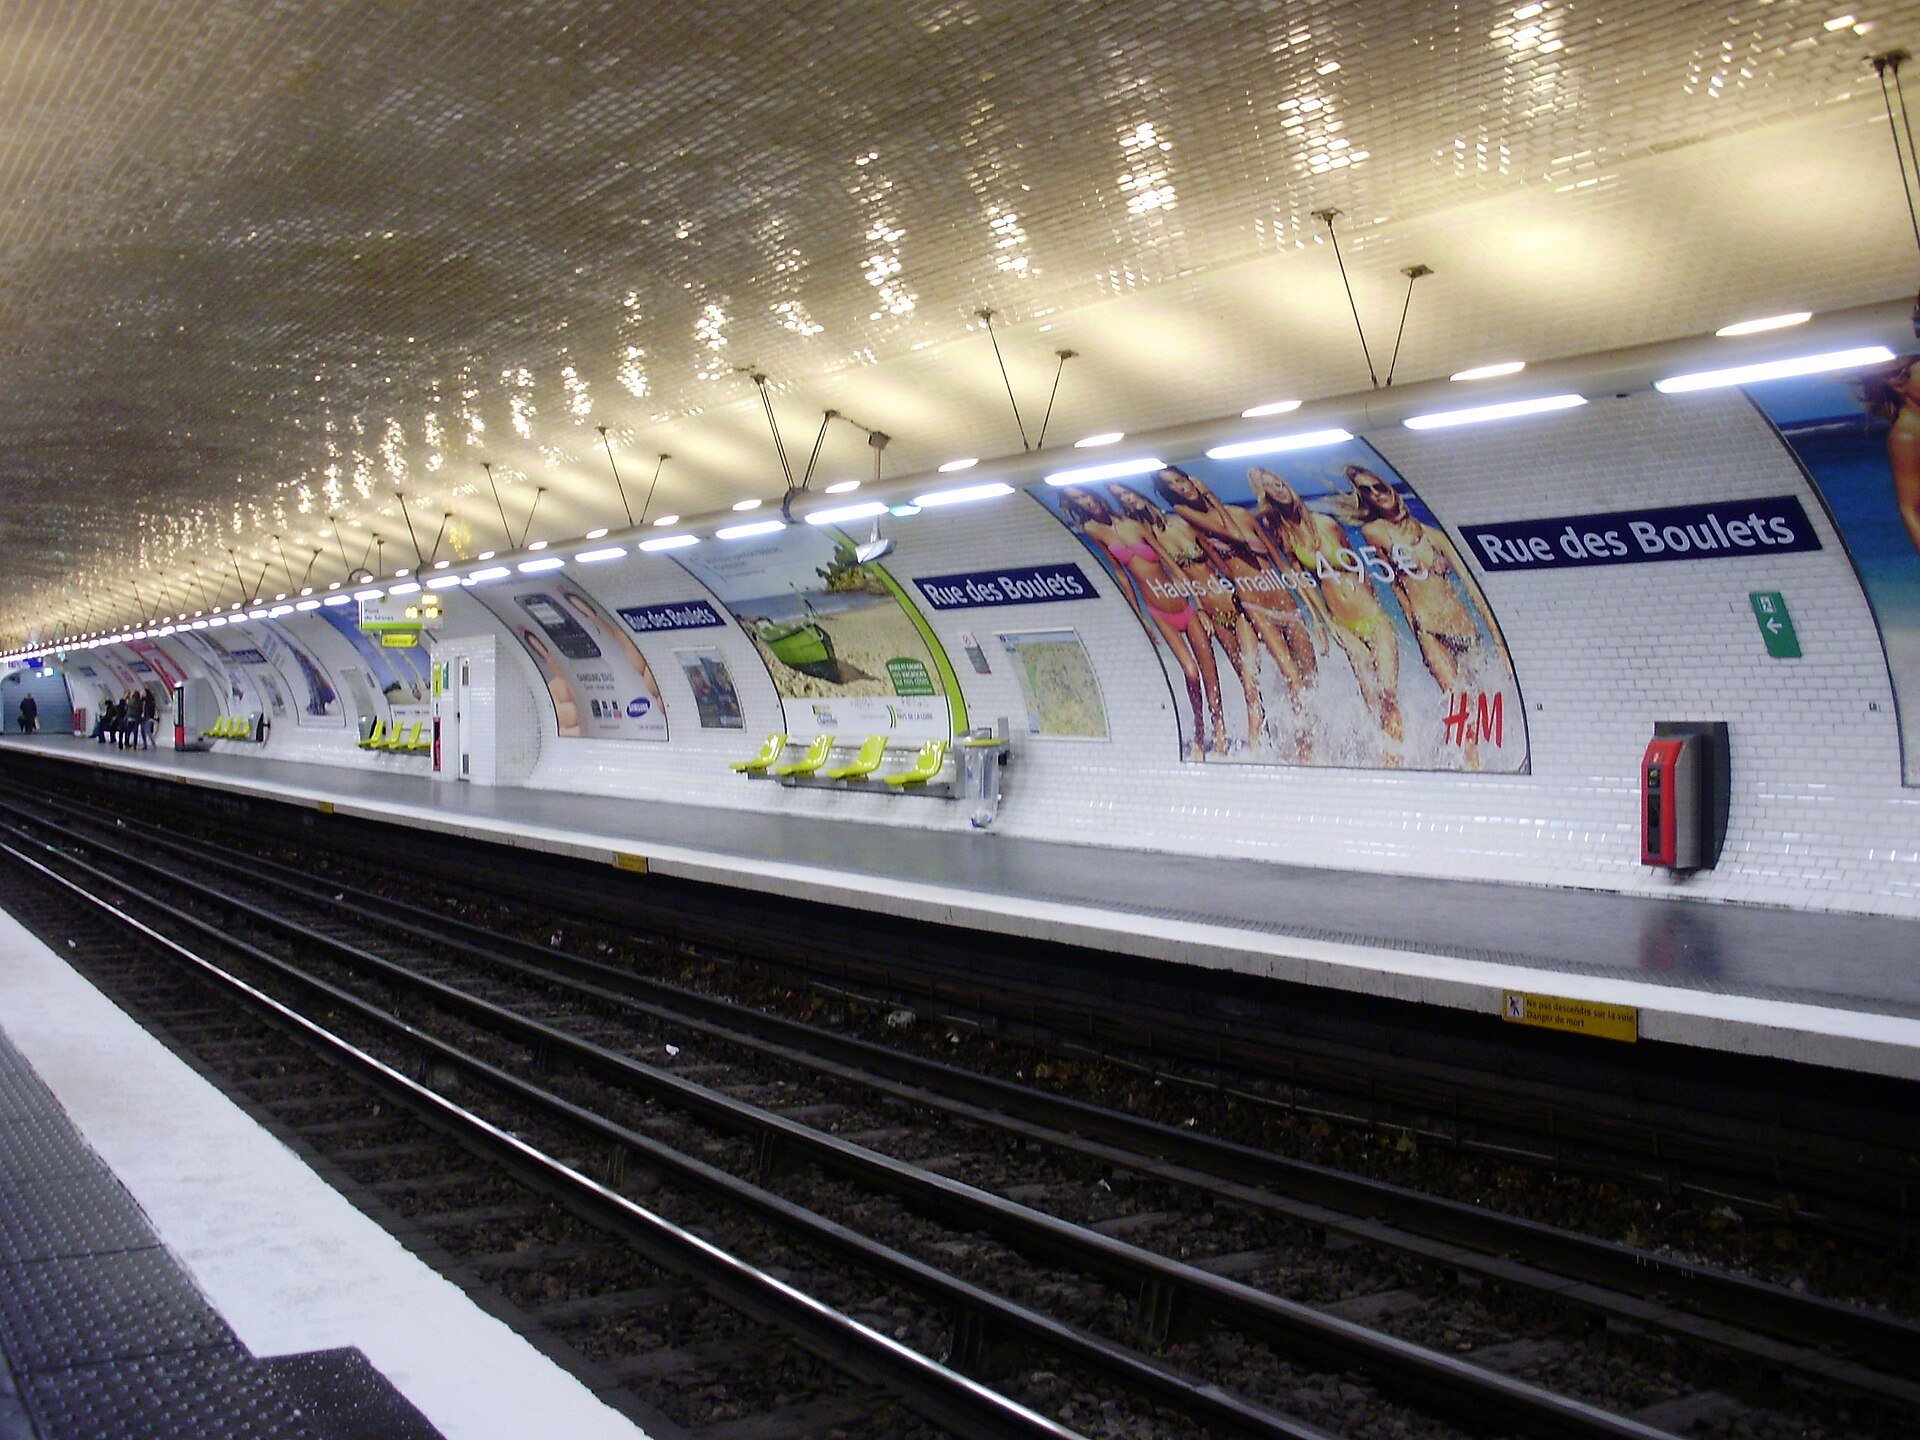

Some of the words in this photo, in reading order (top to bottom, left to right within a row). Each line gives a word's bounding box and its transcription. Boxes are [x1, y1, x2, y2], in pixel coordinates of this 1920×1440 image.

[1477, 533, 1555, 564] Rue
[1559, 526, 1628, 559] des
[1628, 513, 1795, 554] Boulets
[923, 583, 968, 606] Rue
[965, 579, 1004, 602] des
[997, 572, 1084, 600] Boulets
[1145, 578, 1207, 599] Hauts
[1207, 574, 1235, 595] de
[1236, 568, 1317, 593] maillots
[623, 613, 652, 630] Rue
[647, 610, 672, 628] des
[665, 606, 716, 626] Boulets
[1442, 691, 1502, 748] H&M
[1526, 998, 1537, 1008] Ne
[1539, 1001, 1552, 1011] pas
[1553, 1003, 1592, 1017] descendre
[1593, 1010, 1606, 1019] sur
[1607, 1010, 1616, 1020] la
[1617, 1013, 1635, 1022] voie
[1526, 1010, 1553, 1023] Danger
[1555, 1014, 1565, 1024] de
[1566, 1018, 1585, 1028] mort
